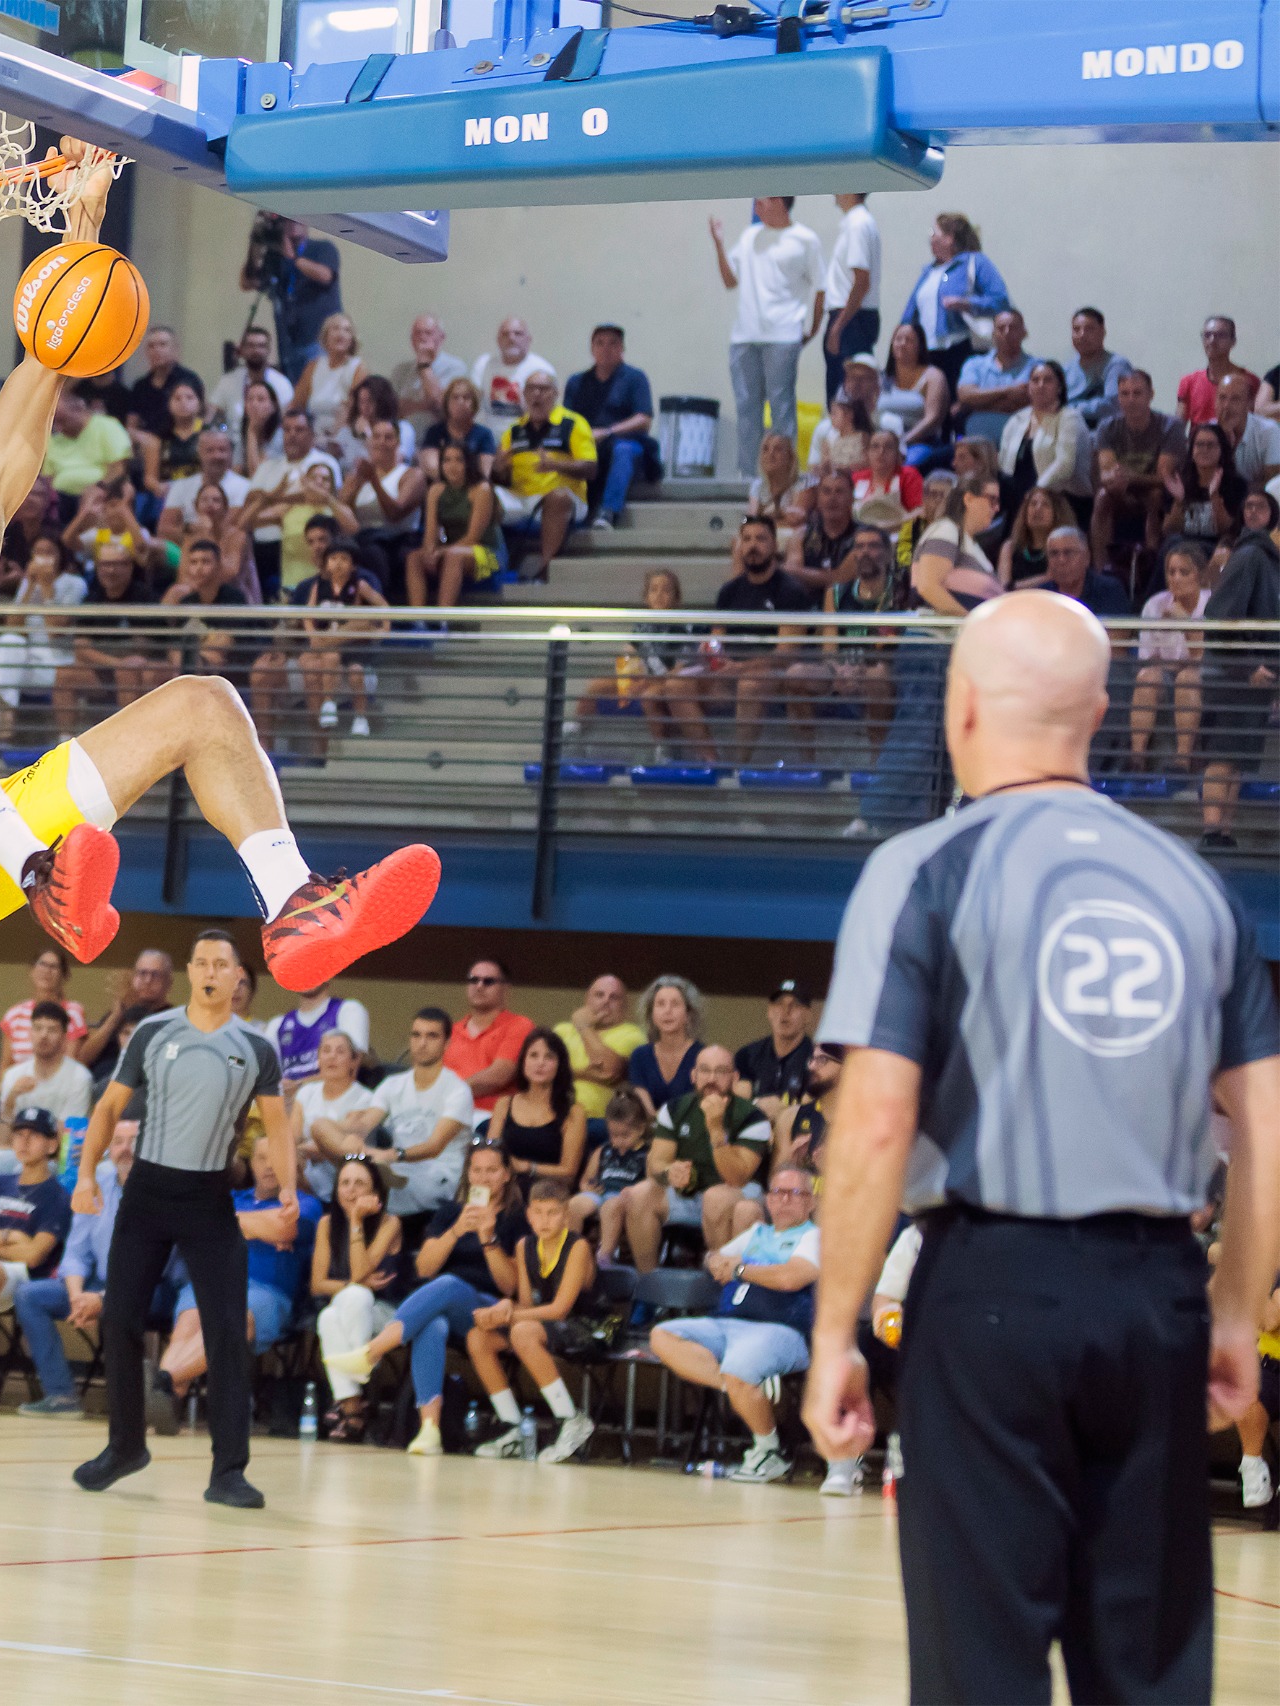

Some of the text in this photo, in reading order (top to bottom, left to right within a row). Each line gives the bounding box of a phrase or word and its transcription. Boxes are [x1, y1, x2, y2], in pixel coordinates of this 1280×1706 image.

[1082, 39, 1245, 80] MONDO
[16, 255, 69, 334] Wilson
[46, 275, 92, 350] liga endesa
[1062, 932, 1163, 1019] 22
